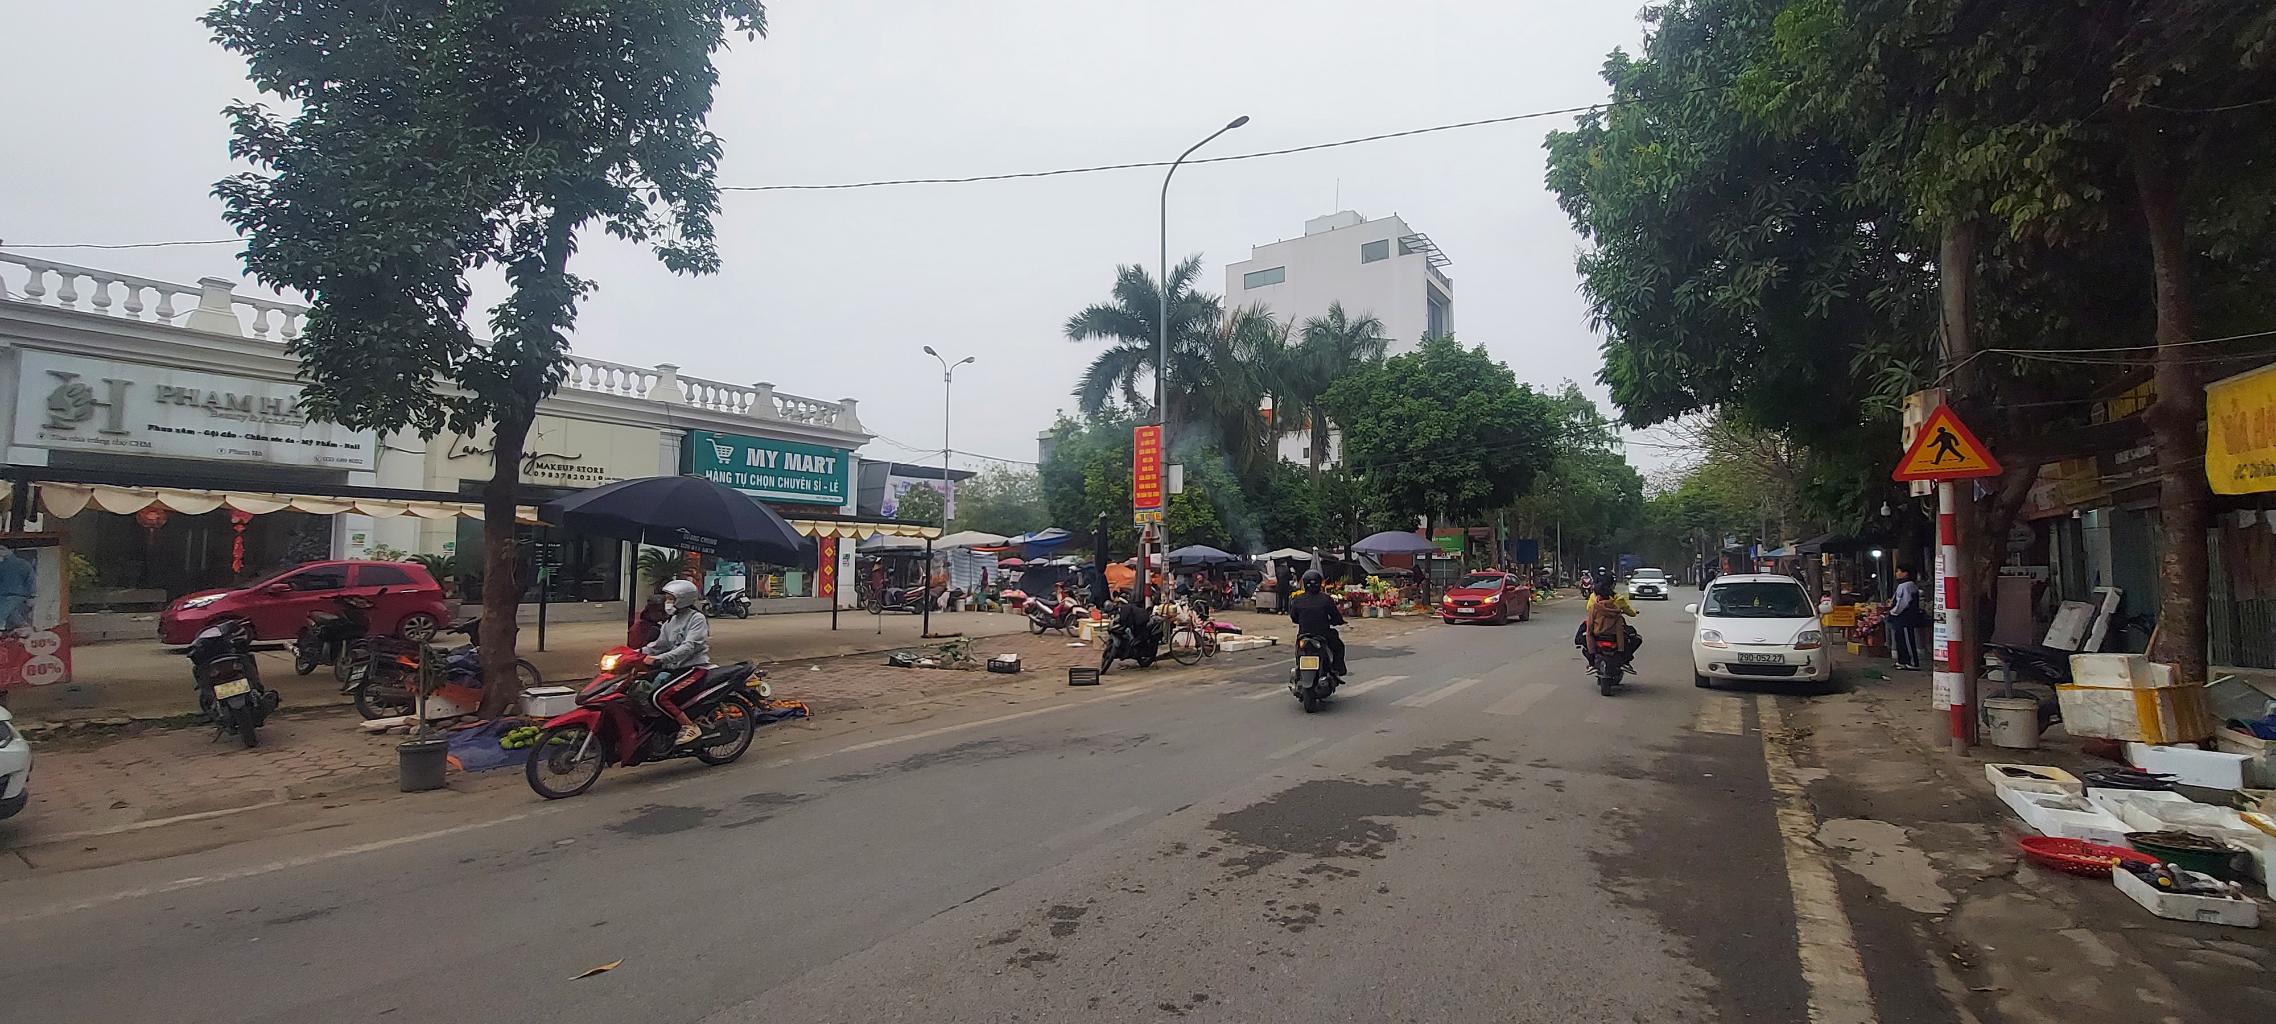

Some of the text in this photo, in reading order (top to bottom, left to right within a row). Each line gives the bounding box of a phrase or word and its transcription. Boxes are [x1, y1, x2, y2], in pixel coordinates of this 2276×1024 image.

[536, 462, 605, 474] MAKEUP STORE
[746, 447, 836, 475] MY MART
[705, 467, 732, 483] HÀNG
[735, 472, 748, 488] TỰ
[750, 474, 775, 489] CHỌN
[777, 476, 811, 491] CHUYÊN
